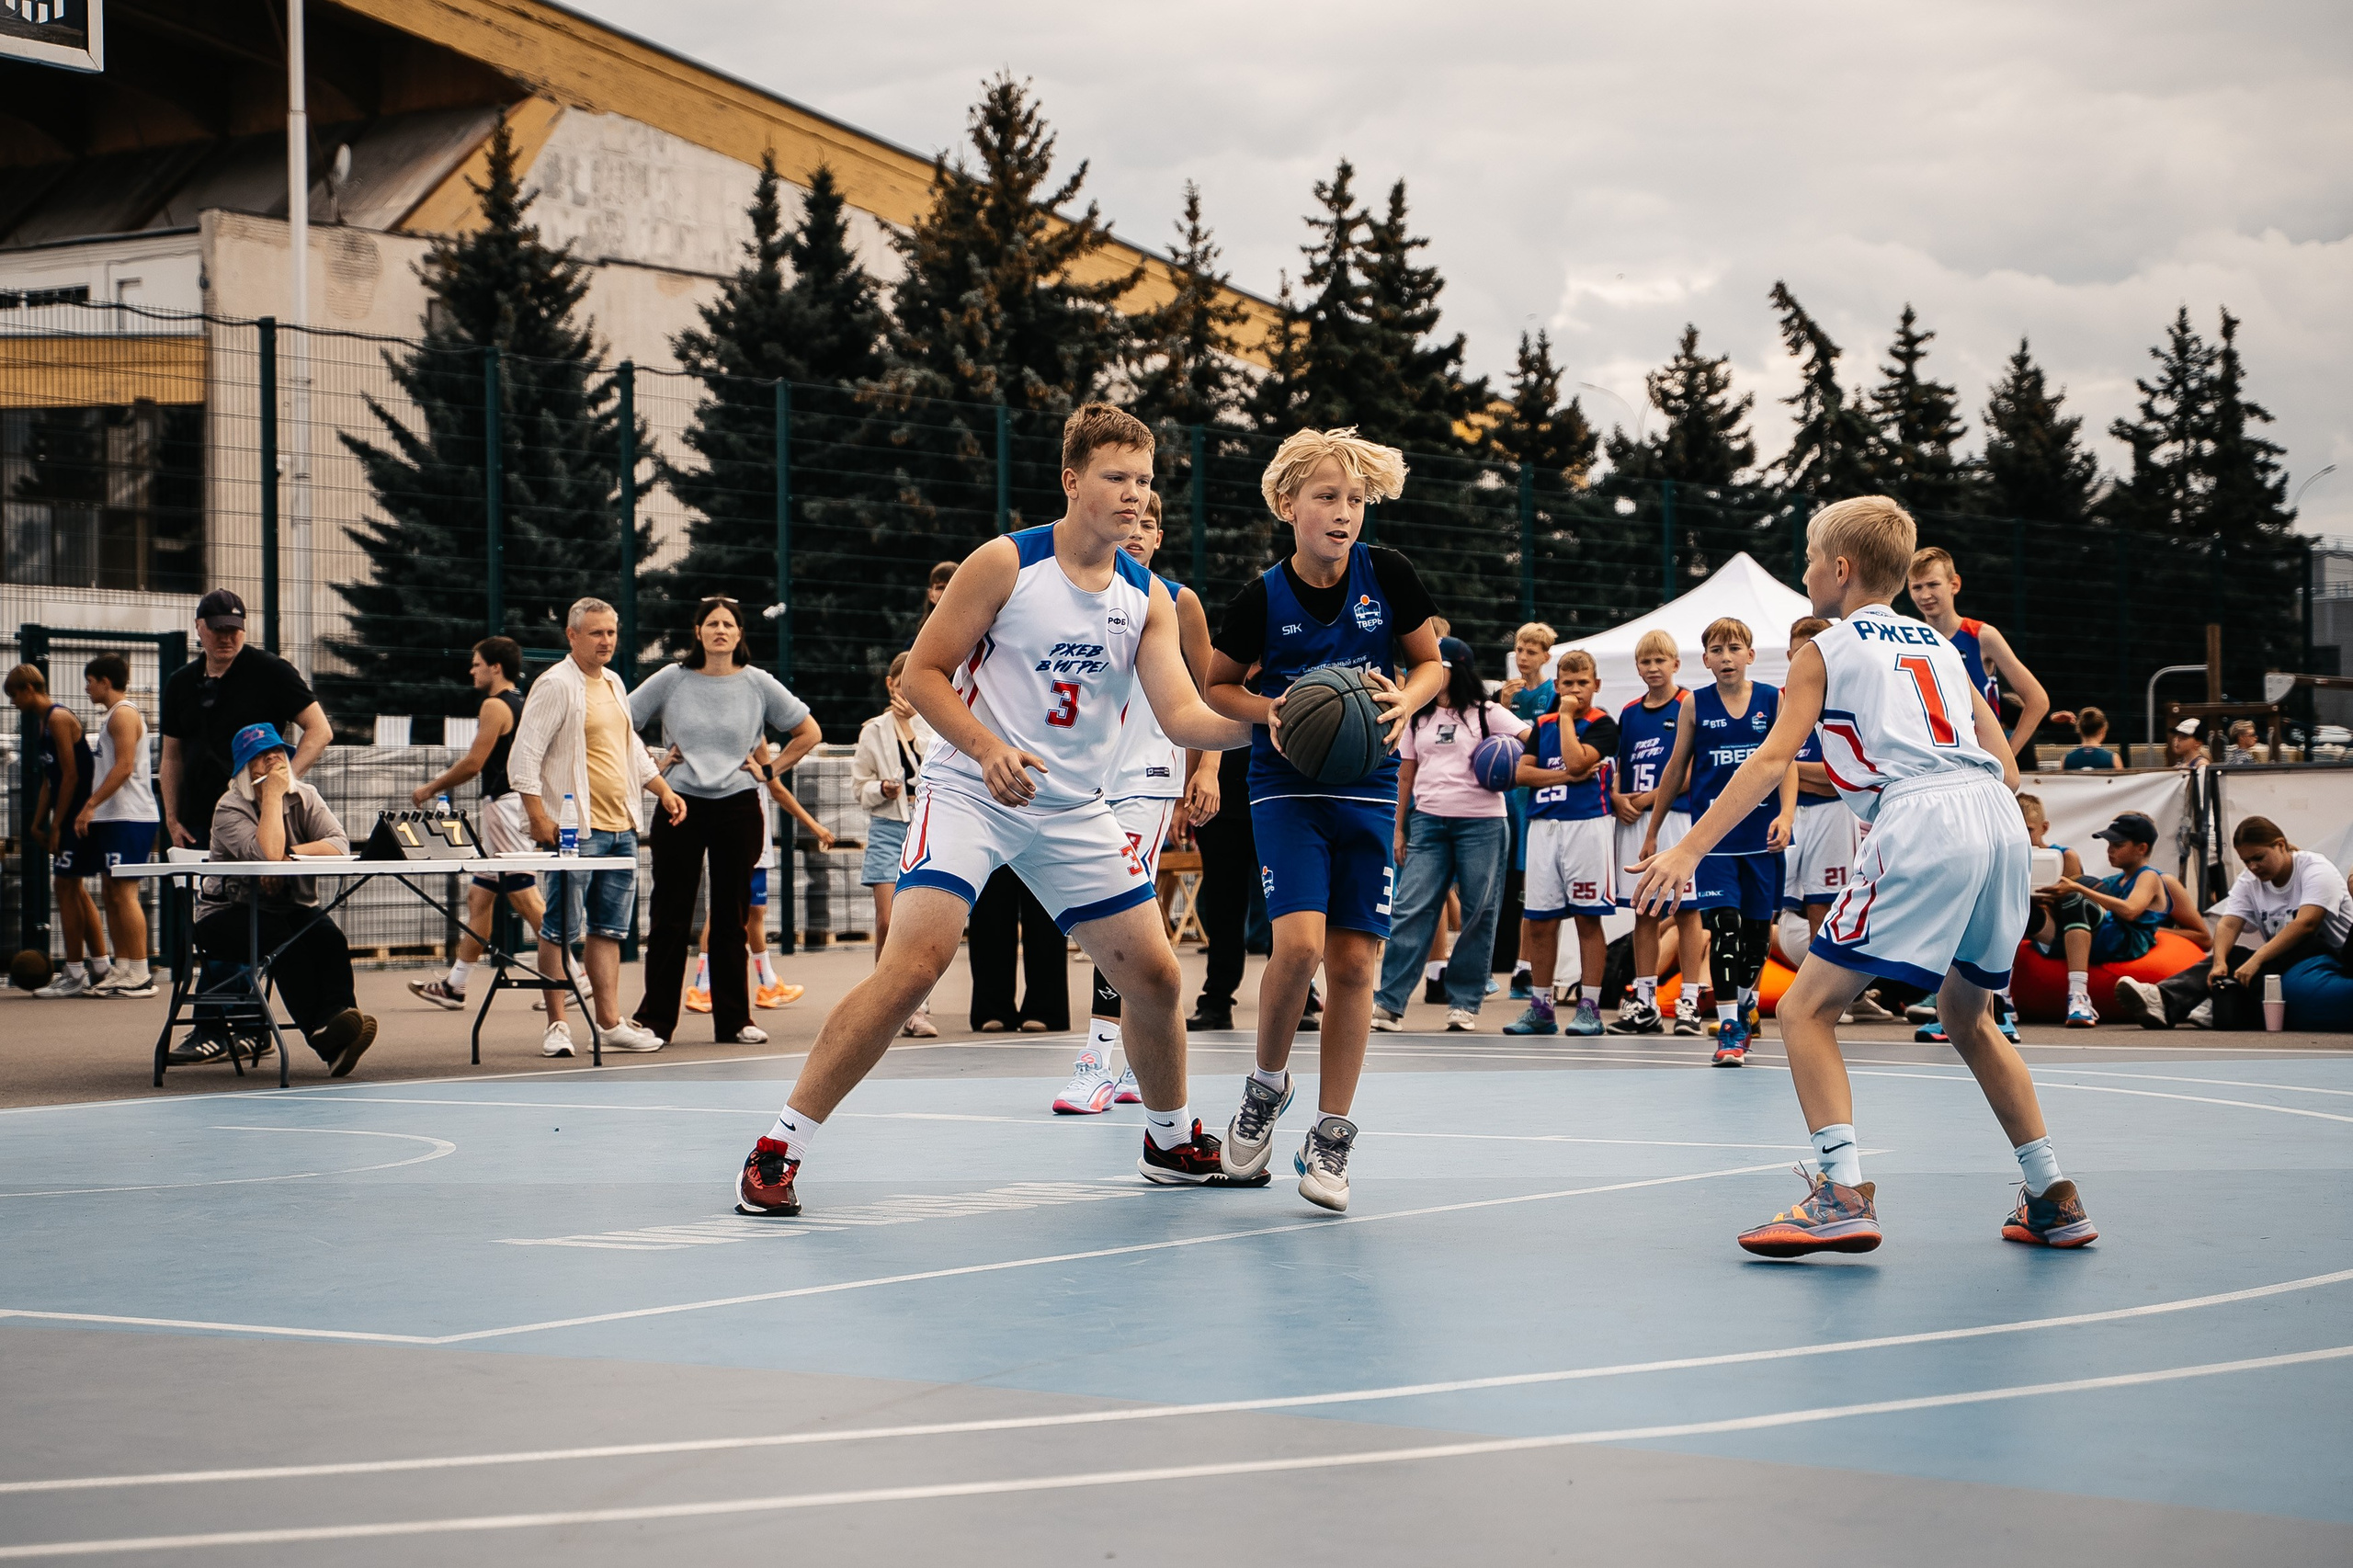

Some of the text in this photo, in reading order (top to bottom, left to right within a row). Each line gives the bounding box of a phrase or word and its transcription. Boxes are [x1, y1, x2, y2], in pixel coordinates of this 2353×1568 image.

[1108, 617, 1127, 626] РФБ
[1281, 623, 1302, 636] STK
[1356, 618, 1383, 630] ТВЕРЬ
[1852, 620, 1941, 647] РЖЕВ
[1049, 642, 1105, 658] РЖЕВ
[1352, 654, 1368, 665] КЛУБ
[1035, 660, 1109, 675] В ИГРЕ!
[1044, 679, 1082, 729] 3
[1894, 653, 1960, 747] 1
[1710, 719, 1728, 729] ВТБ
[1633, 764, 1656, 792] 15
[397, 821, 463, 847] 1 7
[1119, 844, 1144, 878] 3
[1824, 867, 1847, 887] 21
[1375, 866, 1393, 915] 3
[1573, 881, 1597, 900] 25
[489, 1175, 1241, 1251] tverbasket
